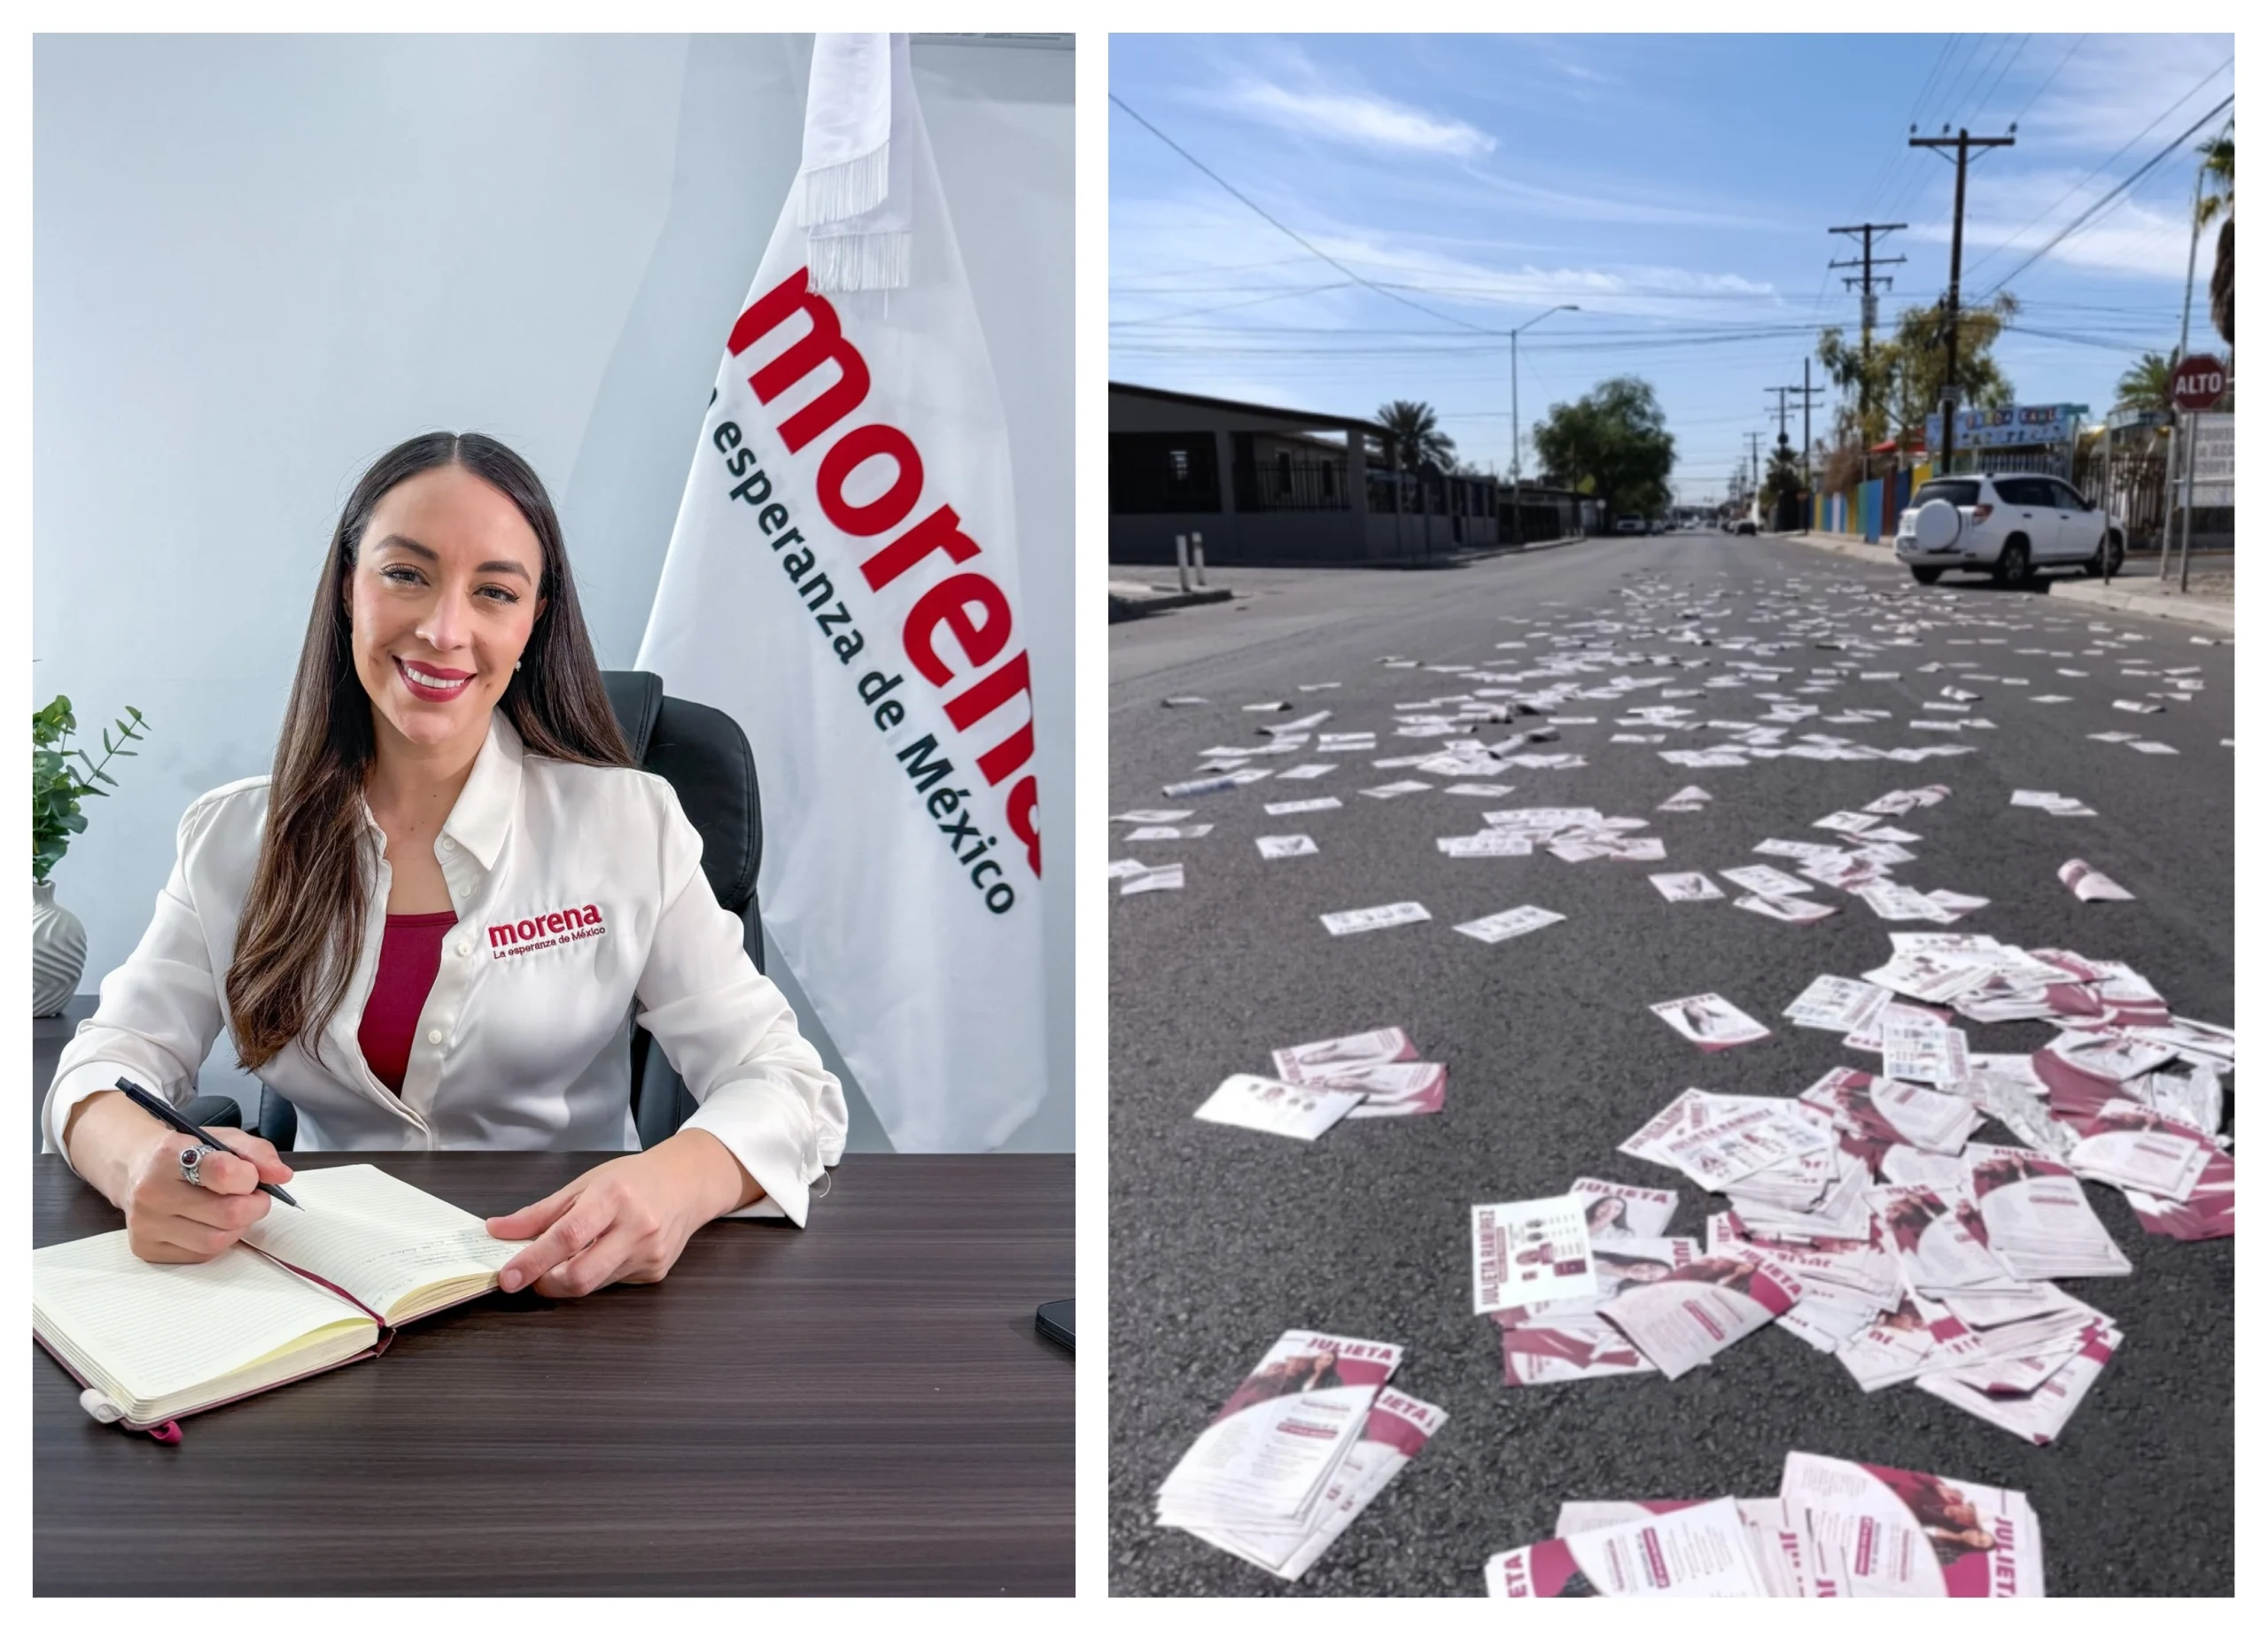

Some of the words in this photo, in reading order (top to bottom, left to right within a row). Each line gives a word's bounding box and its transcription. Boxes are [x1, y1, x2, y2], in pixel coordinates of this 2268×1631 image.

[2175, 372, 2221, 395] ALTO
[712, 420, 866, 665] esperanza
[857, 668, 905, 732] de
[897, 734, 1015, 916] México
[488, 904, 602, 948] morena
[493, 951, 506, 959] La
[508, 939, 556, 956] esperanza
[558, 935, 571, 944] de
[571, 928, 606, 942] México
[1573, 1177, 1669, 1205] JULIETA
[1480, 1258, 1499, 1306] JULIETA
[1738, 1249, 1803, 1296] JULIETA
[1306, 1337, 1395, 1362] JULIETA
[1381, 1394, 1428, 1422] IETA
[1994, 1515, 2016, 1598] JULIET
